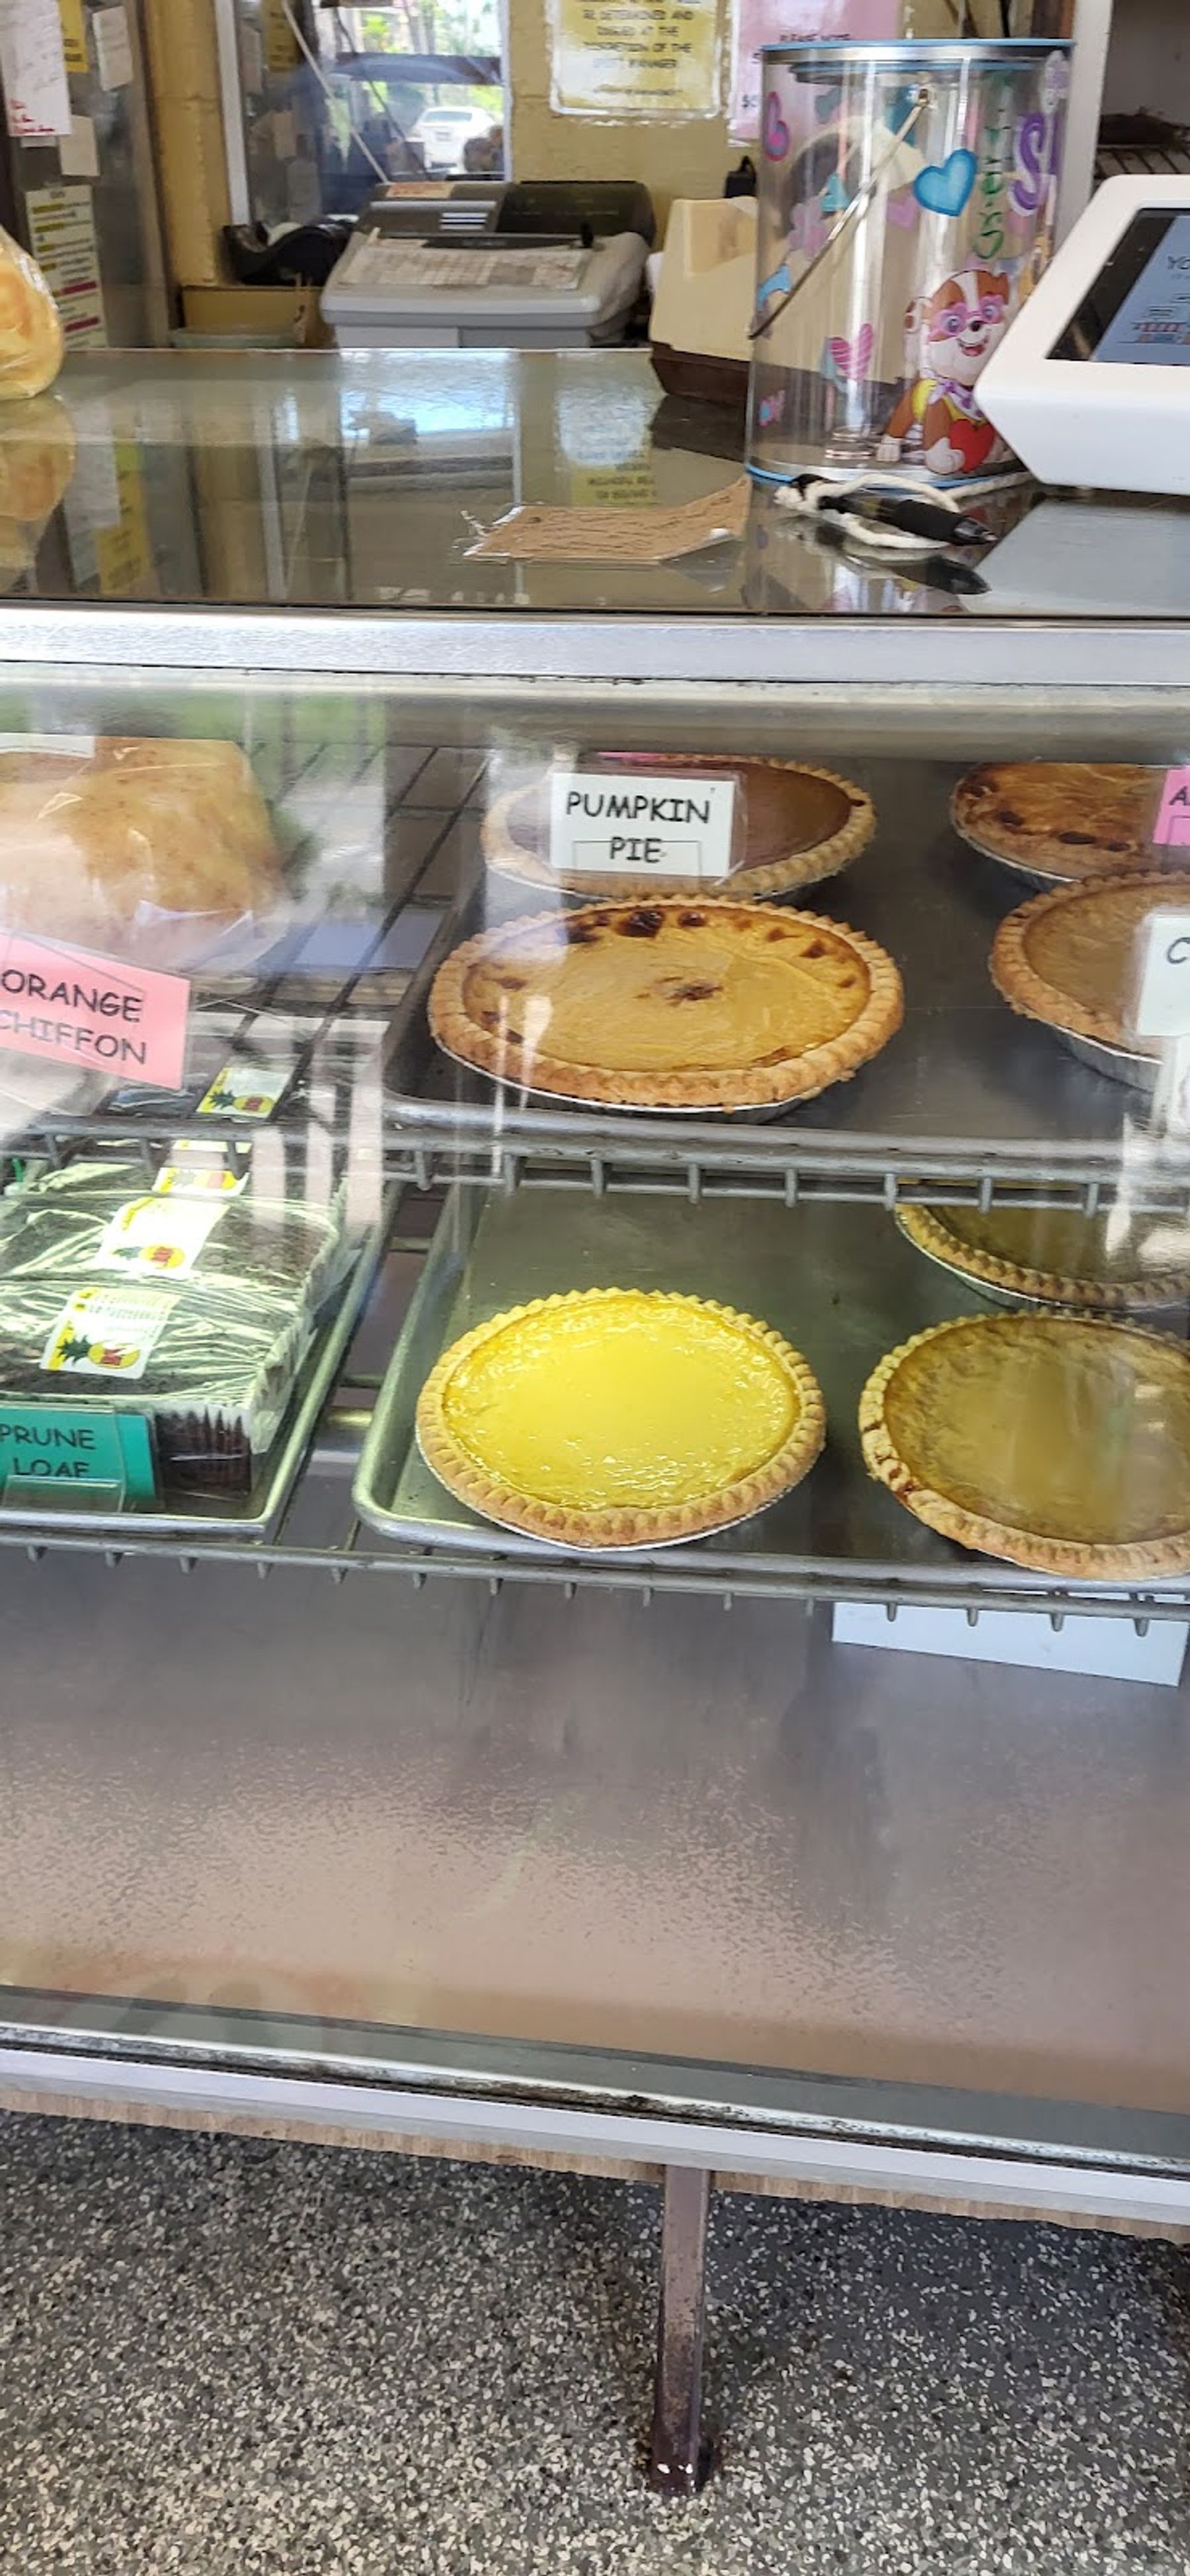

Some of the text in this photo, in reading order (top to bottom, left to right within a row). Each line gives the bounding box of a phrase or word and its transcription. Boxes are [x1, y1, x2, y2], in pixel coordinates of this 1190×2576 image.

[567, 791, 710, 824] PUMPKIN
[610, 836, 662, 863] PIE
[1, 969, 143, 1023] ORANGE
[0, 1009, 146, 1065] CHIFFON
[0, 1424, 97, 1450] PRUNE
[13, 1458, 90, 1477] LOAF
